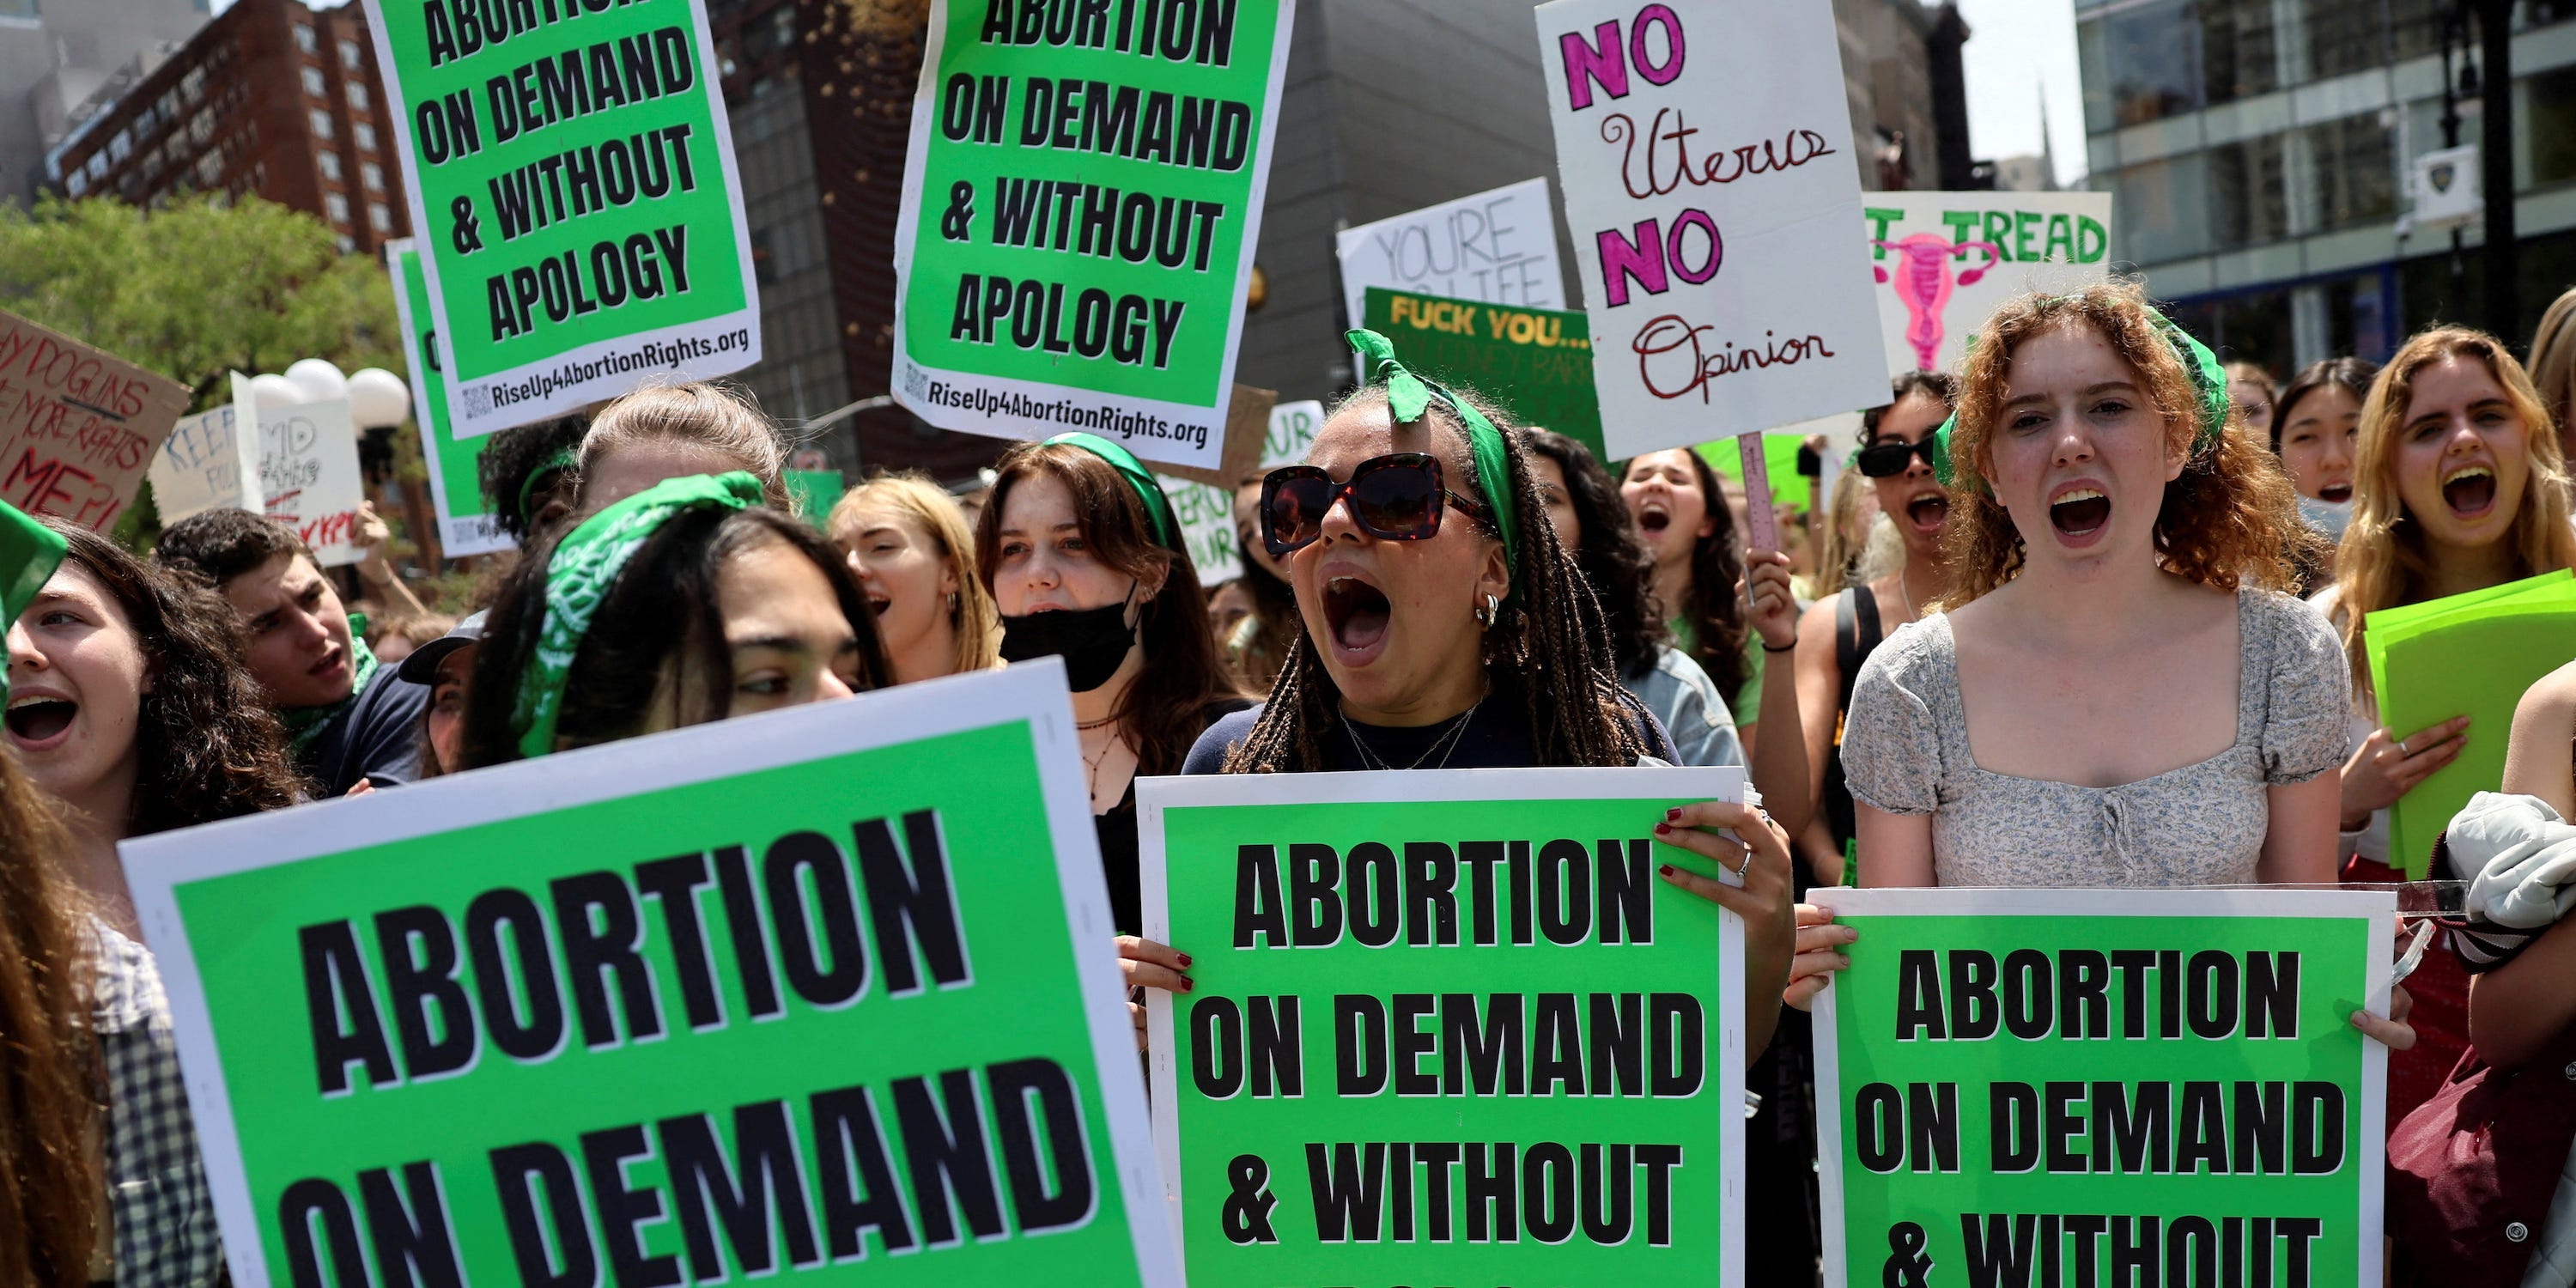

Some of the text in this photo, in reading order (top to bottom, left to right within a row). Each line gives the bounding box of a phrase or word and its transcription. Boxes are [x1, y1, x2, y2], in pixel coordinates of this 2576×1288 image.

[423, 0, 651, 68] ABOR
[1558, 3, 1685, 111] NO
[416, 25, 695, 166] ON DEMAND
[941, 72, 1252, 173] ON DEMAND
[450, 123, 695, 255] & WITHOUT
[1601, 107, 1836, 198] Uterus
[940, 176, 1224, 274] & WITHOUT
[1596, 208, 1722, 308] NO
[1943, 210, 2107, 264] TREAD
[486, 223, 690, 343] APOLOGY
[950, 273, 1186, 370] APOLOGY
[1390, 295, 1477, 337] FUCK
[492, 328, 749, 409] RiseUp4AbortionRights.org
[1532, 348, 1593, 386] BARR
[1632, 314, 1835, 405] Opinion
[928, 380, 1207, 450] RiseUp4AbortionRights.org
[1233, 838, 1654, 950] ABORTION
[297, 808, 975, 1100] ABORTION
[1895, 948, 2301, 1042] ABORTION
[1190, 994, 1303, 1100] ON
[1334, 992, 1705, 1099] DEMAND
[278, 1055, 1100, 1288] ON DEMAND
[1855, 1081, 1959, 1176] ON
[1990, 1080, 2347, 1176] DEMAND
[1221, 1142, 1683, 1248] & WITHOUT
[1881, 1213, 2323, 1288] & WITHOUT
